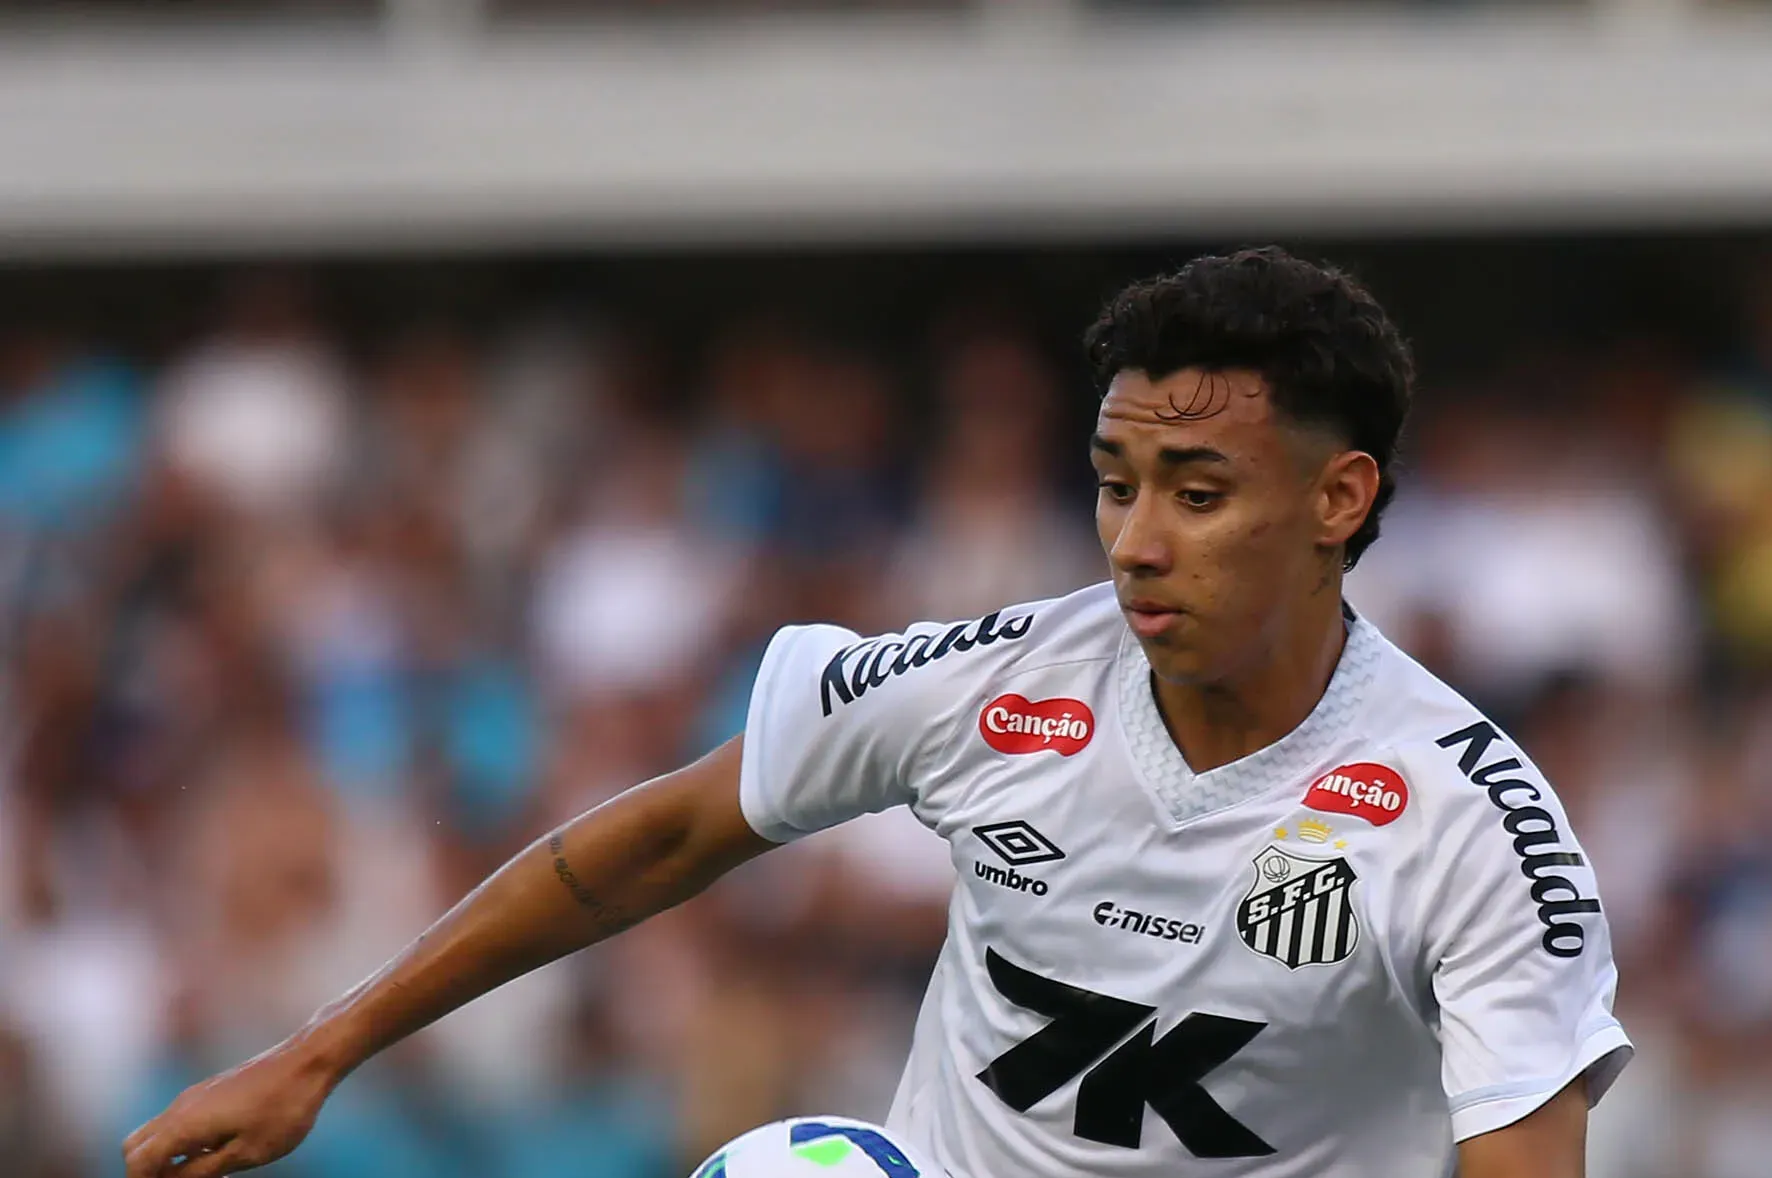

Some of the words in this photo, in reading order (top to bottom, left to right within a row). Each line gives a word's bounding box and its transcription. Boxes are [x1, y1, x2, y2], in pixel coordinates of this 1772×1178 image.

[985, 707, 1088, 744] Canção
[1316, 774, 1401, 812] anção
[974, 860, 1049, 897] umbro
[975, 945, 1279, 1159] 7K
